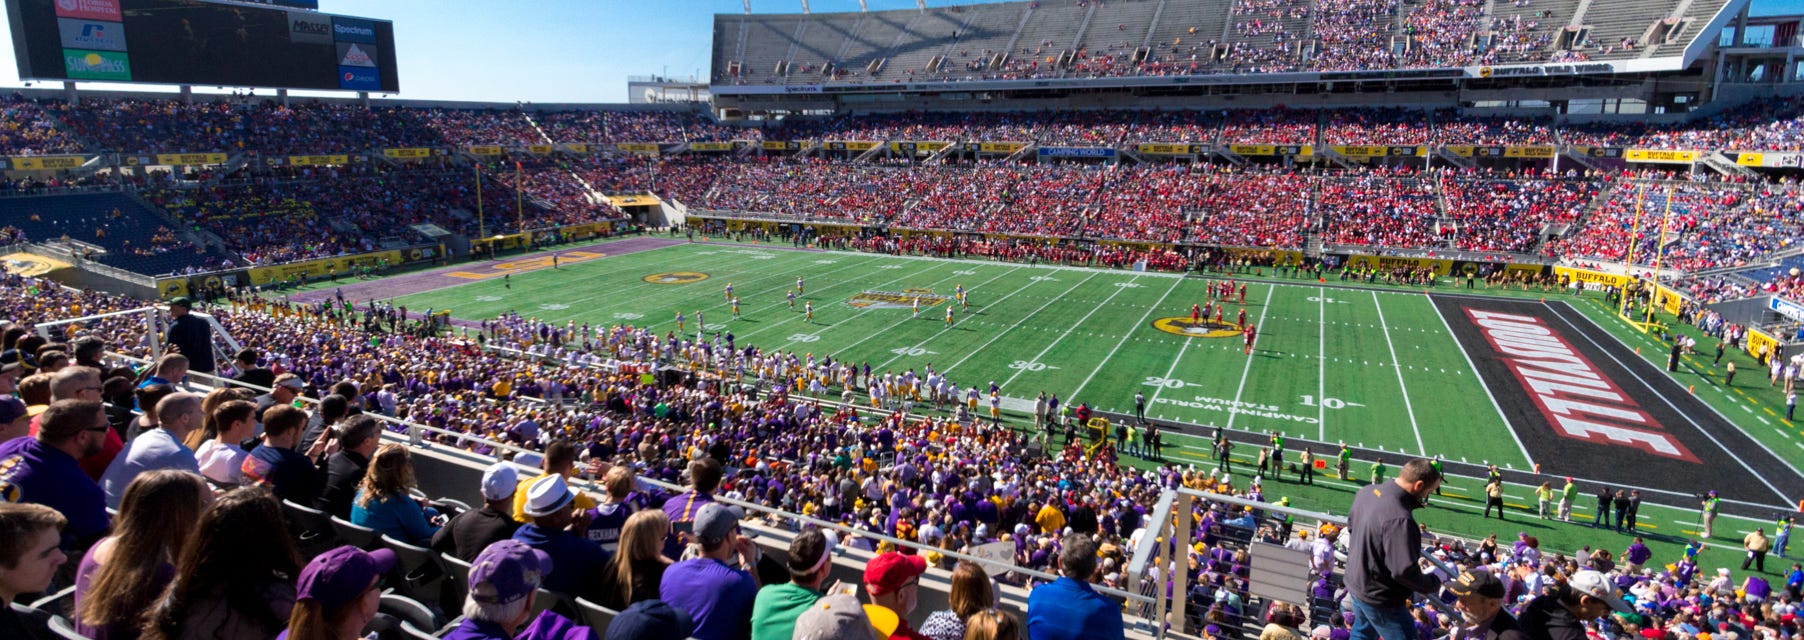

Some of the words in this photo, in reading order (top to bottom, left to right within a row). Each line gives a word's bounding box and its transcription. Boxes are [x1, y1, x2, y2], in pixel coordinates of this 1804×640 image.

[334, 24, 374, 36] Spectrum
[1493, 67, 1541, 76] BUFFALO
[1545, 65, 1571, 74] WILD
[1575, 63, 1611, 73] WINGS
[785, 85, 817, 93] Spectrum
[1047, 148, 1077, 157] CAMPING
[1079, 148, 1106, 157] WORLD
[1575, 271, 1617, 284] BUFFALO
[1008, 360, 1046, 371] 30
[1142, 376, 1184, 389] 20
[1468, 308, 1683, 457] LOUISVILLE
[1155, 397, 1223, 412] WORLD
[1194, 395, 1279, 412] STADIUM
[1298, 394, 1344, 409] 10
[1227, 405, 1319, 424] CAMPING
[588, 528, 619, 541] BECKHAM
